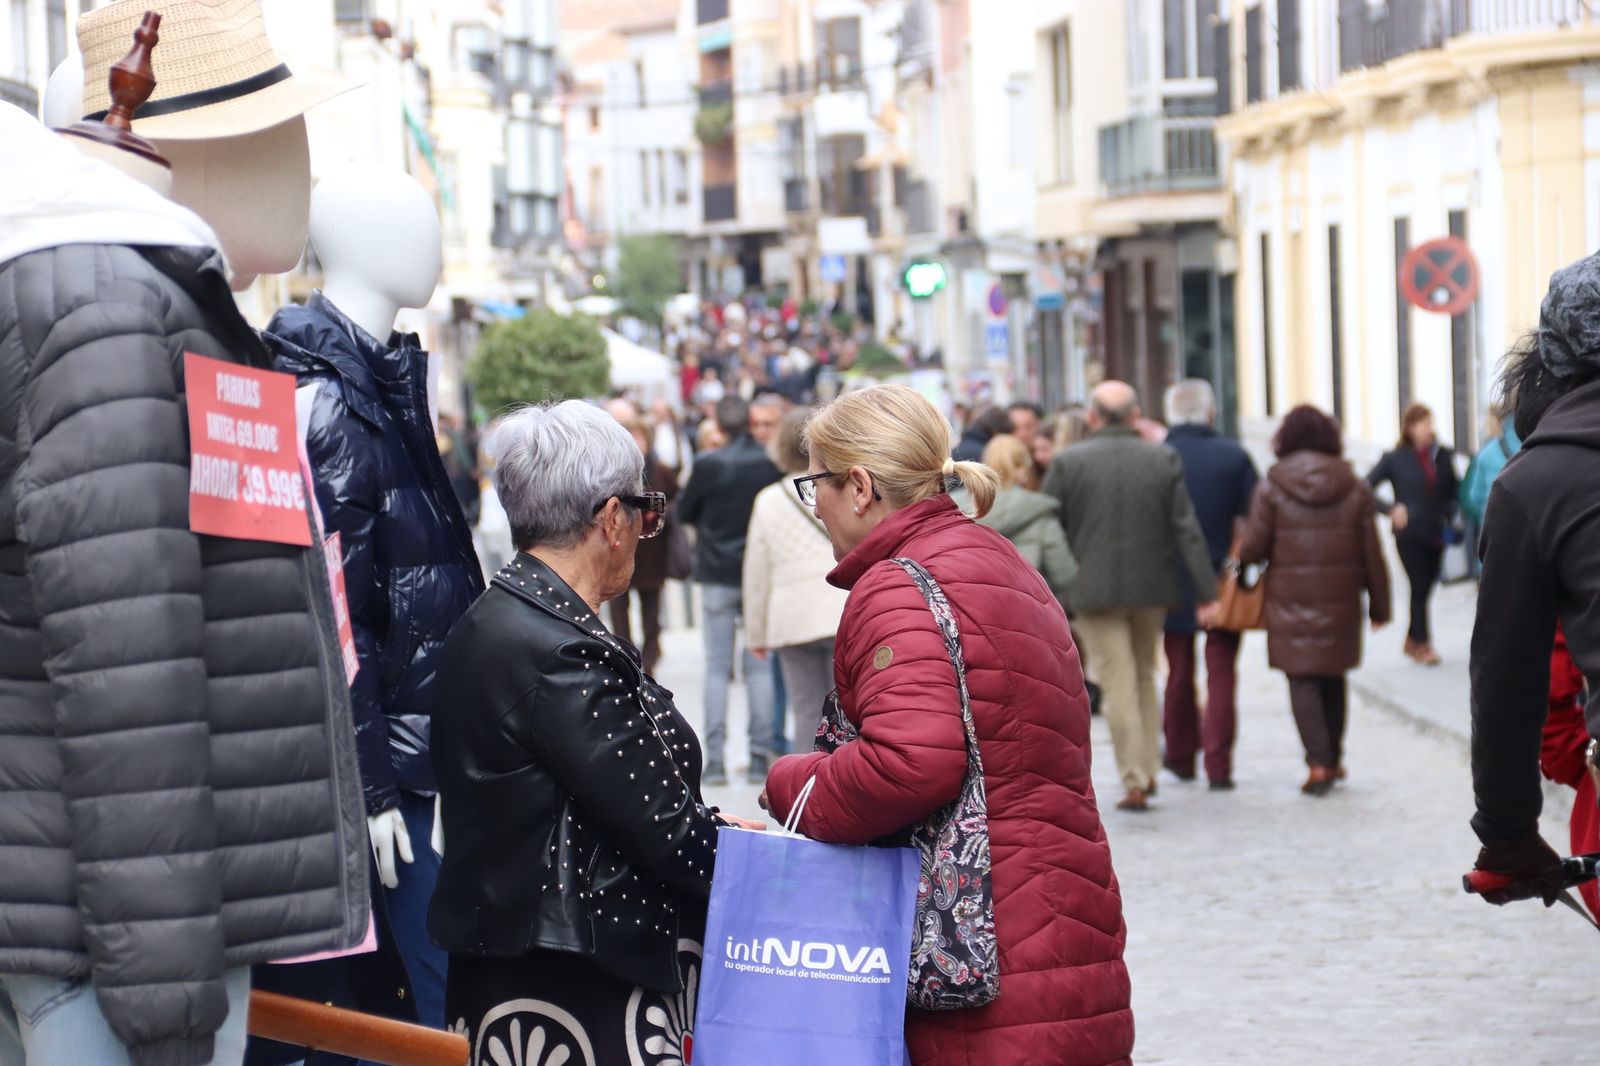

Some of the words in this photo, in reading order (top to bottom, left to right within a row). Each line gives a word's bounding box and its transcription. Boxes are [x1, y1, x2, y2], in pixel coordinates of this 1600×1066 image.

[215, 371, 261, 409] PARKAS
[206, 411, 236, 445] ANTES
[236, 419, 279, 453] 69.00€
[190, 453, 239, 501] AHORA
[242, 463, 305, 511] 39.99€
[724, 960, 734, 969] tu
[735, 963, 775, 974] operador
[776, 967, 797, 977] local
[798, 969, 809, 978] de
[810, 971, 891, 984] telecomunicaciones
[726, 936, 891, 974] intNOVA
